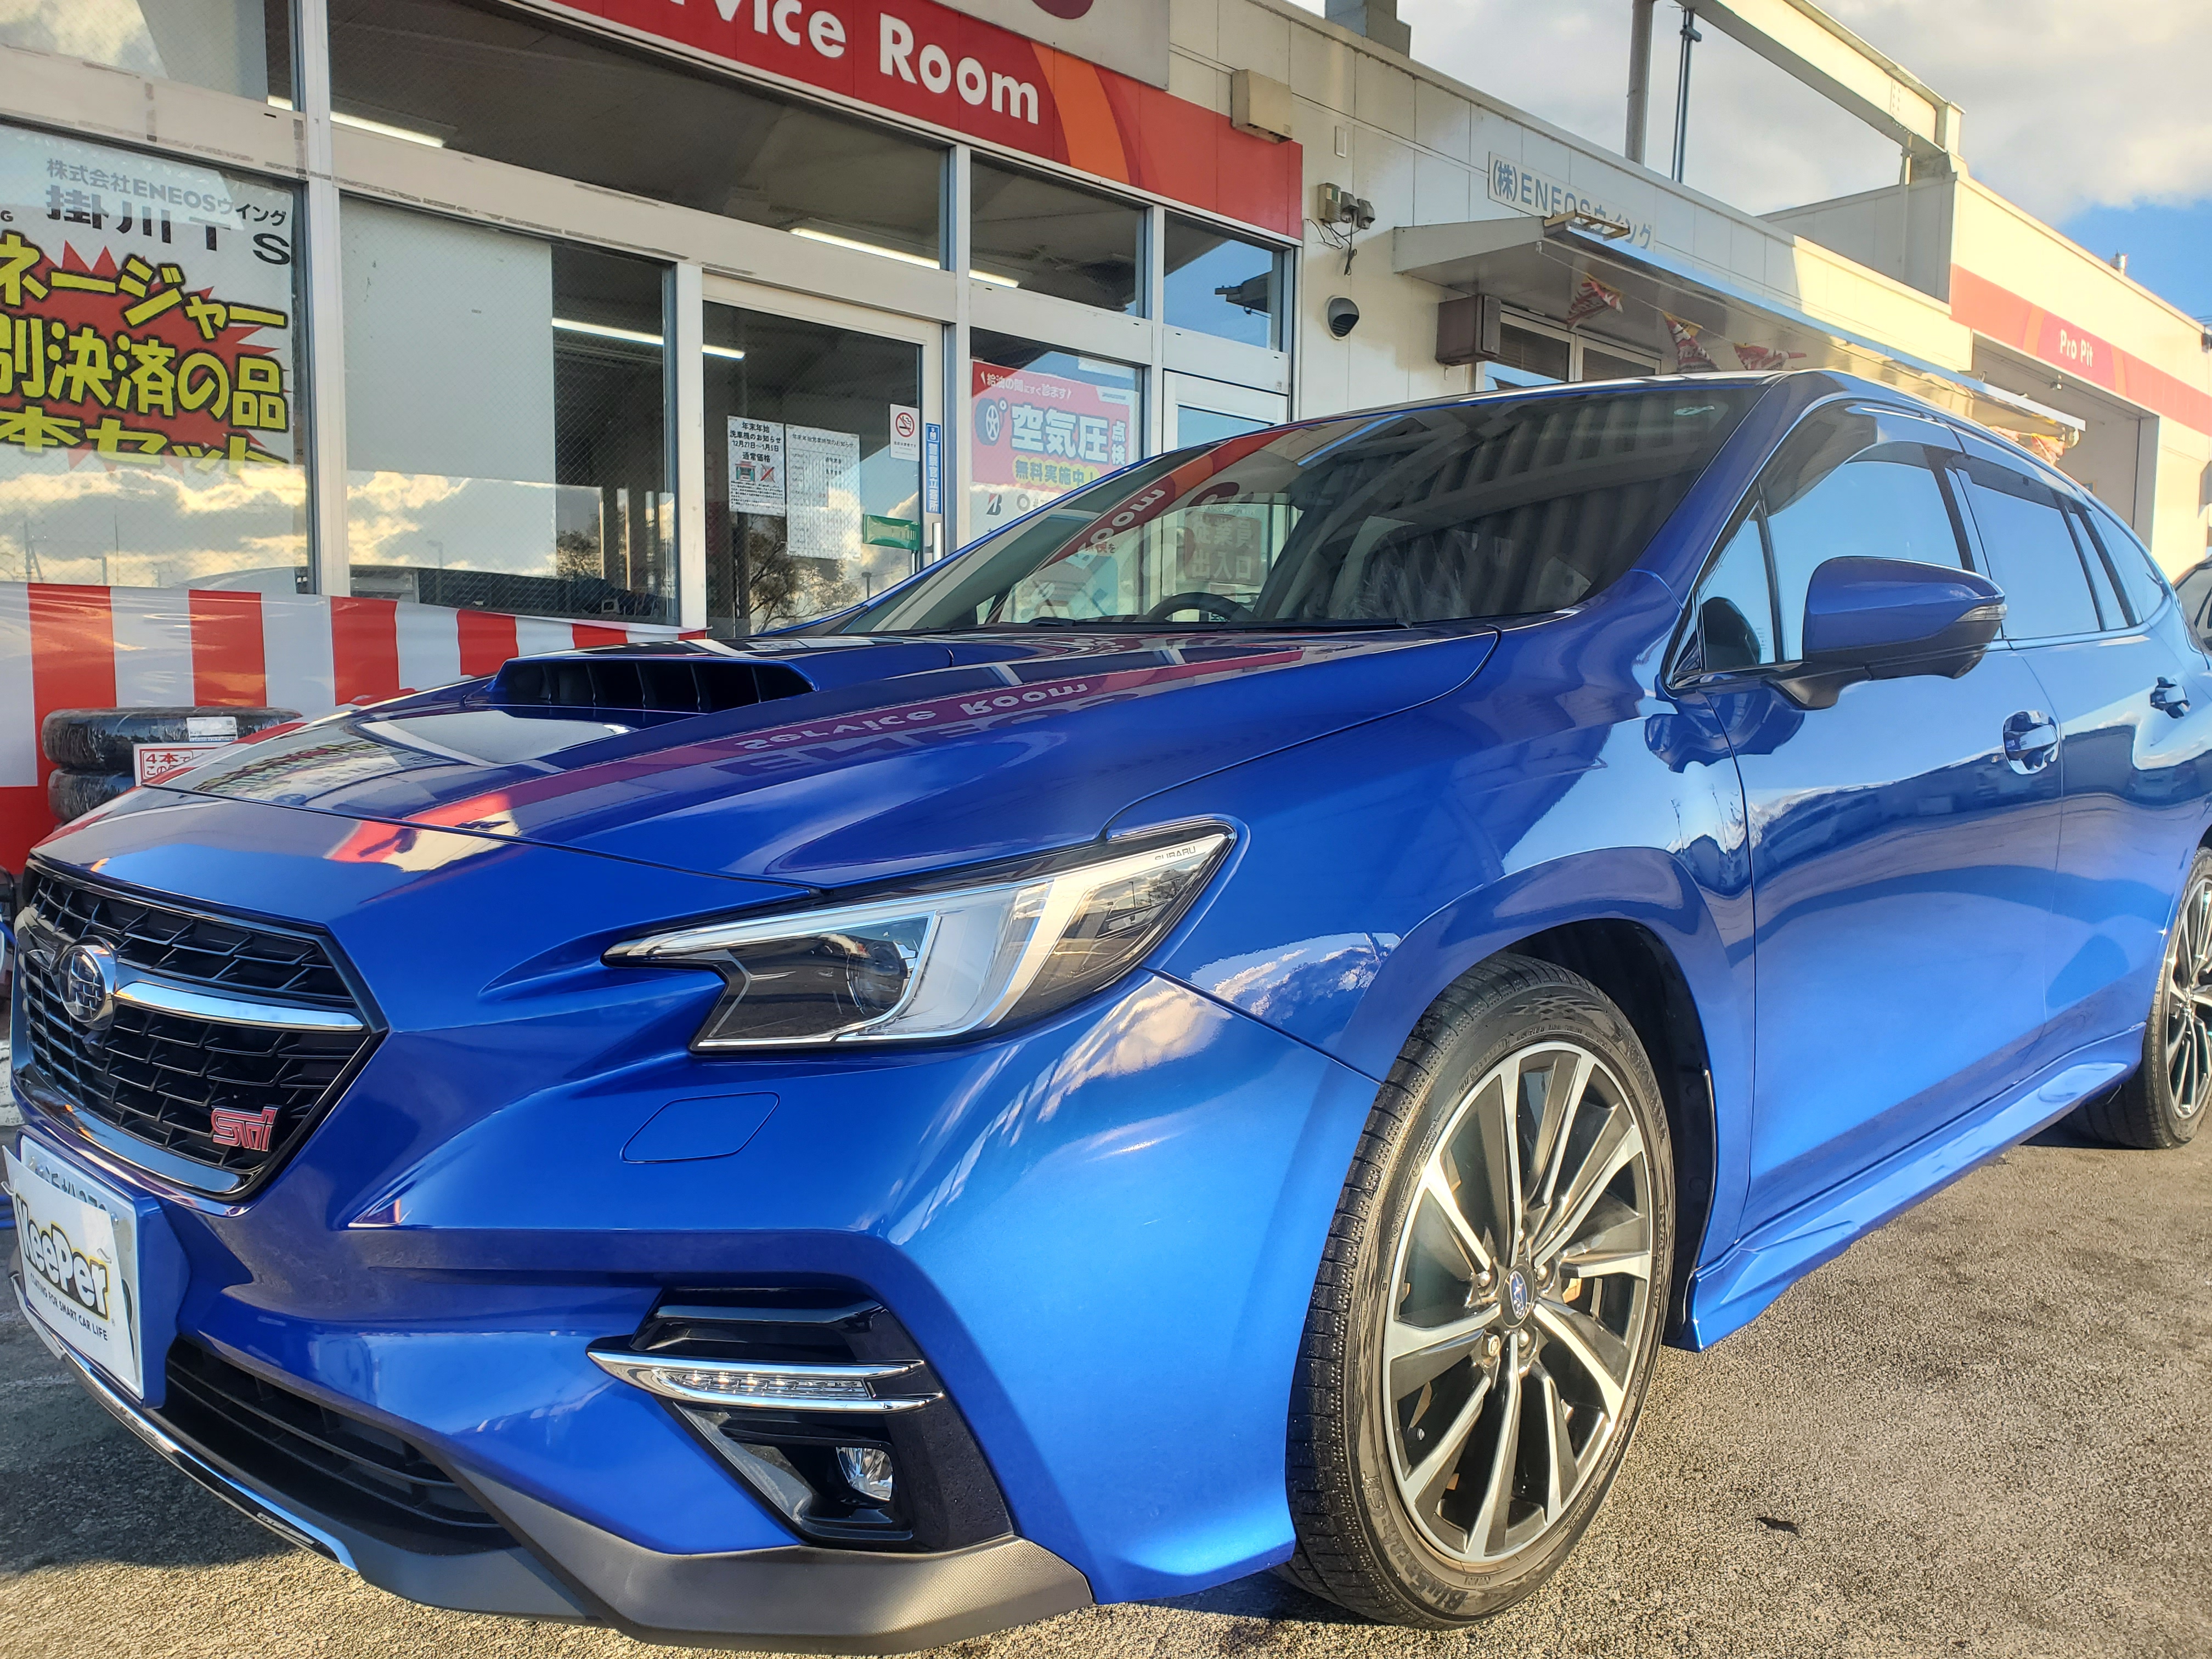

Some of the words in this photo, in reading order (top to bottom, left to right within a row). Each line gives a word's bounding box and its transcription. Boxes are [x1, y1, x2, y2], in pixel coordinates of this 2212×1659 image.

[879, 13, 1039, 125] Room
[47, 158, 287, 227] 株式会社ENEOSウイング
[2060, 329, 2078, 360] Pro
[2080, 338, 2093, 368] Pit
[0, 405, 289, 475] 本セット
[730, 430, 782, 444] 洗車機のお知らせ
[742, 421, 770, 433] 年末年始
[1011, 404, 1108, 463] 空気圧
[742, 451, 770, 463] 通常価格
[1191, 548, 1252, 580] 出入口
[48, 1290, 59, 1308] FOR
[59, 1300, 77, 1322] SMART
[78, 1315, 91, 1331] CAR
[92, 1323, 108, 1341] LIFE
